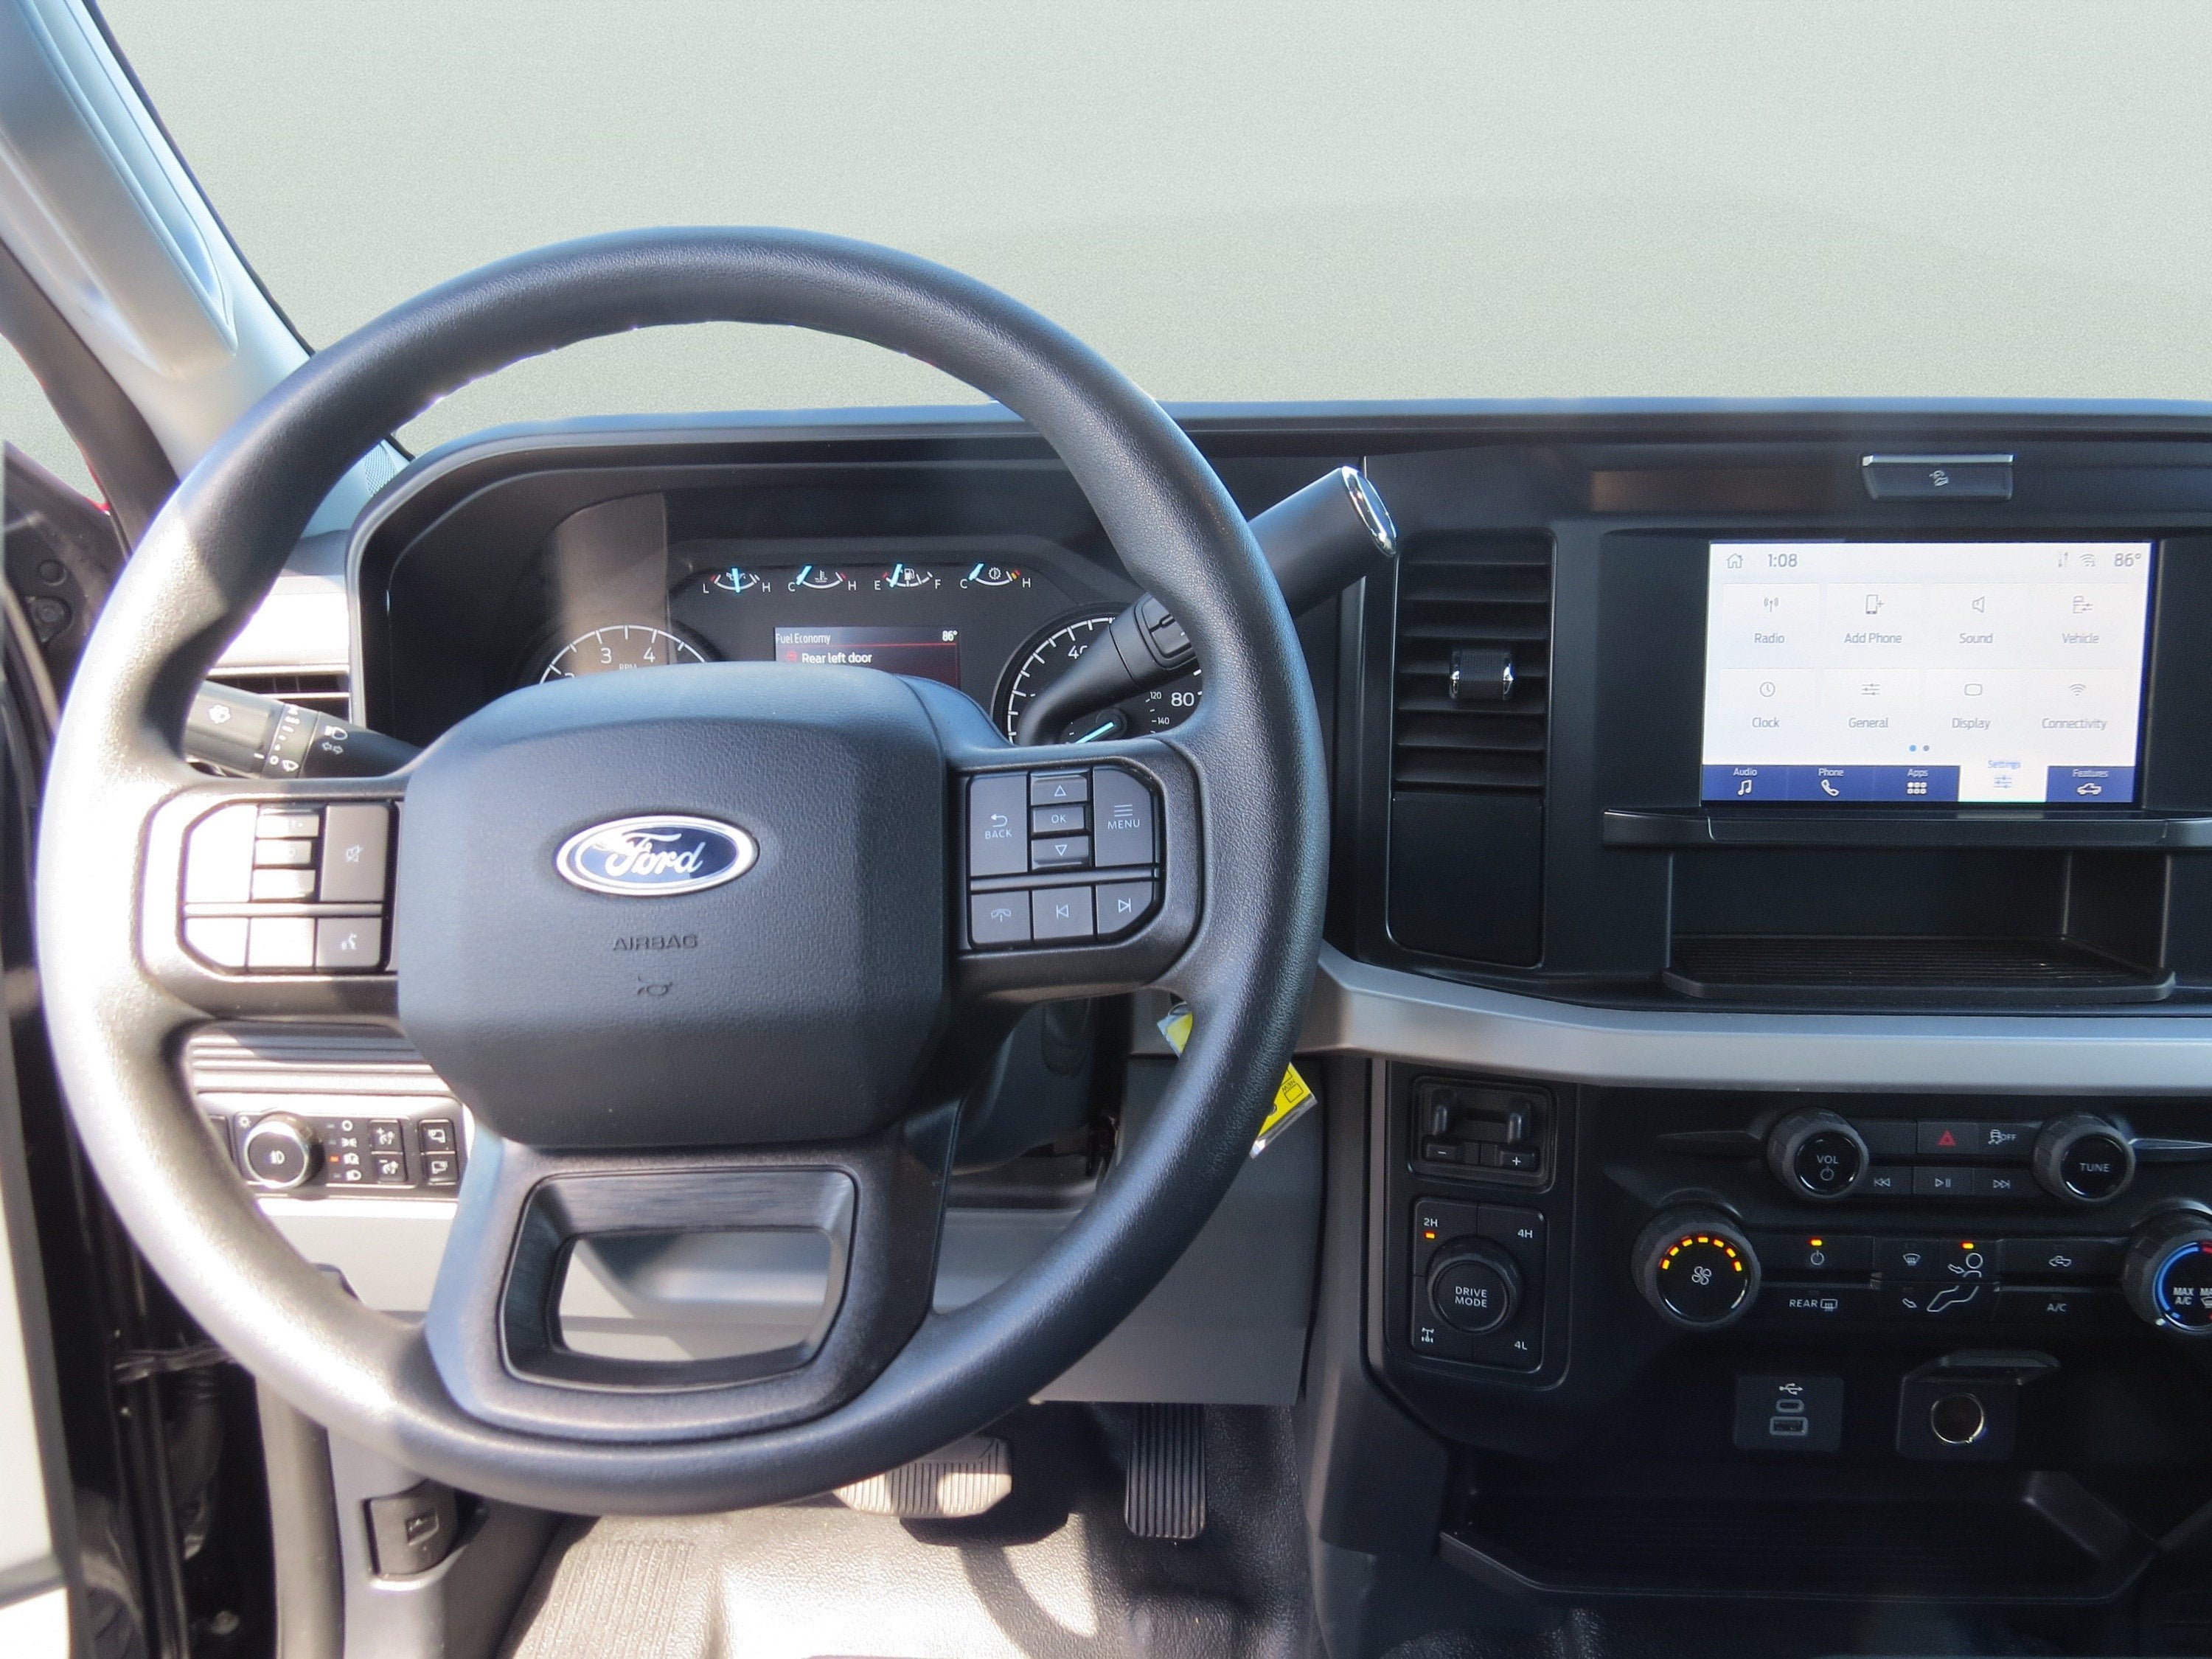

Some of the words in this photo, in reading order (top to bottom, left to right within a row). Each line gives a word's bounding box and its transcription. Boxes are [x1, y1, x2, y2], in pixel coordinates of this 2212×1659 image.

[1767, 553, 1798, 568] 1:08
[703, 582, 709, 594] L
[762, 582, 771, 593] H
[787, 582, 796, 592] C
[848, 580, 857, 591] H
[874, 580, 881, 590] E
[935, 579, 942, 589] F
[959, 578, 968, 589] C
[1022, 577, 1032, 588] H
[776, 633, 793, 644] Fuel
[794, 633, 831, 645] Economy
[1754, 633, 1785, 644] Radio
[1844, 633, 1866, 644] Add
[1868, 633, 1902, 644] Phone
[1959, 633, 1994, 644] Sound
[2062, 633, 2100, 644] Vehicle
[600, 647, 613, 664] 3
[643, 647, 655, 663] 4
[801, 653, 825, 664] Rear
[827, 652, 846, 663] left
[848, 650, 872, 663] door
[1150, 691, 1162, 700] 120
[1171, 692, 1194, 707] 80
[1158, 717, 1170, 726] 140
[1752, 717, 1780, 728] Clock
[1848, 717, 1888, 728] General
[1952, 718, 1991, 730] Display
[2042, 718, 2107, 731] Connectivity
[1988, 760, 2022, 770] Settings
[1733, 768, 1757, 776] Audio
[1818, 768, 1844, 776] Phone
[1907, 768, 1928, 778] Apps
[2073, 769, 2109, 778] Features
[1051, 814, 1066, 824] OK
[1107, 819, 1141, 830] MENU
[984, 829, 1012, 839] BACK
[605, 832, 706, 876] Ford
[613, 935, 698, 951] AIRBAG
[1281, 1079, 1295, 1091] NEW
[2001, 1133, 2017, 1141] OFF
[1816, 1155, 1839, 1165] VOL
[2079, 1162, 2110, 1173] TUNE
[1423, 1217, 1438, 1227] 2H
[1517, 1229, 1533, 1238] 4H
[1455, 1286, 1487, 1298] DRIVE
[2173, 1287, 2194, 1296] MAX
[2199, 1287, 2212, 1296] MA
[1455, 1296, 1487, 1308] MODE
[1789, 1298, 1818, 1308] REAR
[1514, 1340, 1528, 1350] 4L
